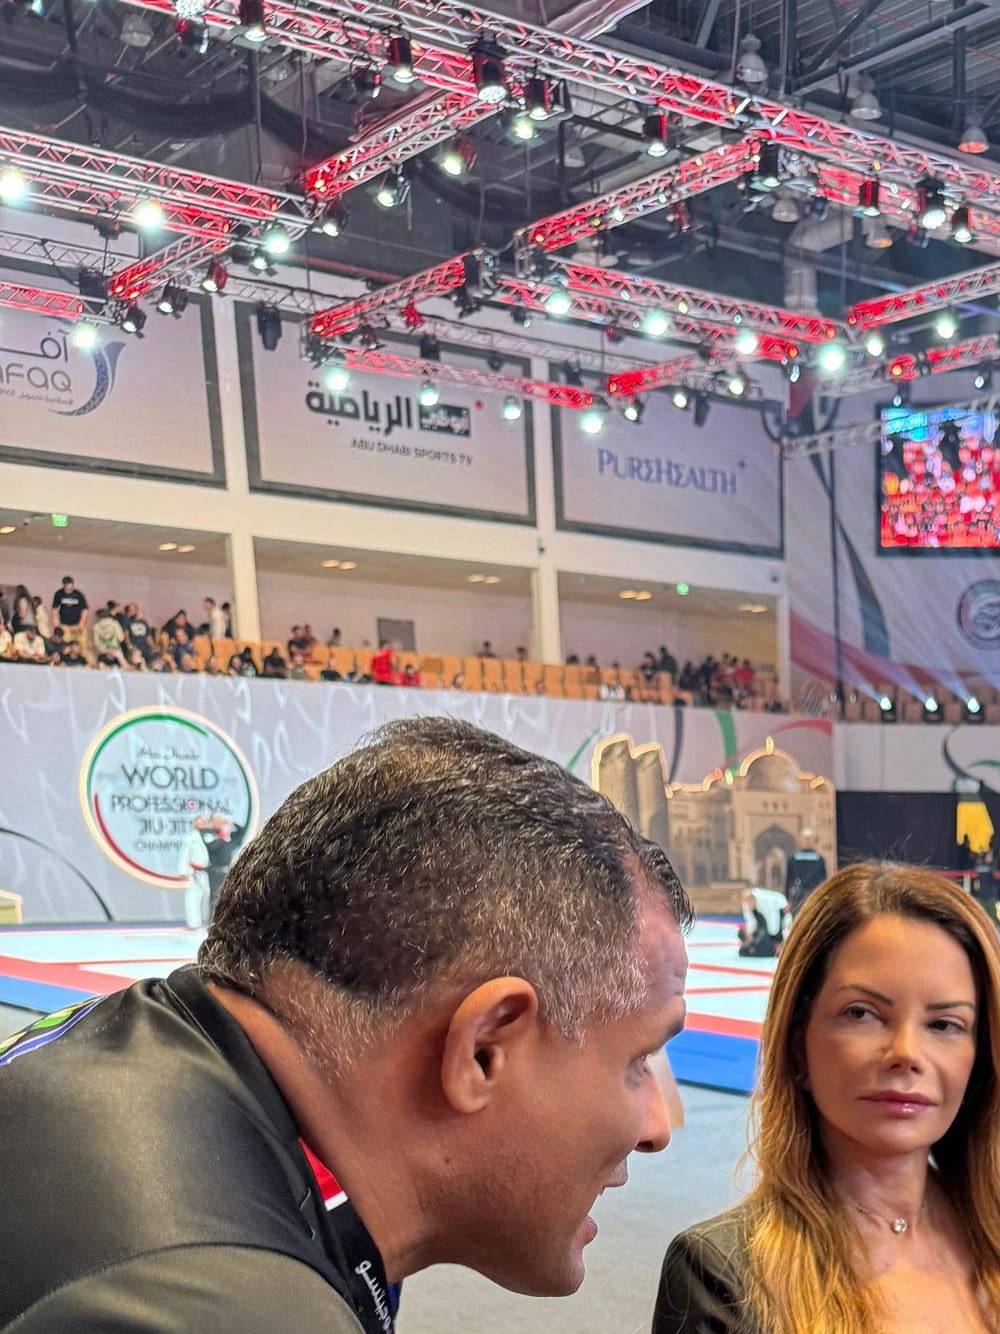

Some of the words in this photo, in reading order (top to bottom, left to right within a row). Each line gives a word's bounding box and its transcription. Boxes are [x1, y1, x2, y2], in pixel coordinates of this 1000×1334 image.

[121, 764, 220, 791] WORLD
[112, 795, 231, 815] PROFESSIONAL
[139, 816, 192, 834] JIU-JIT
